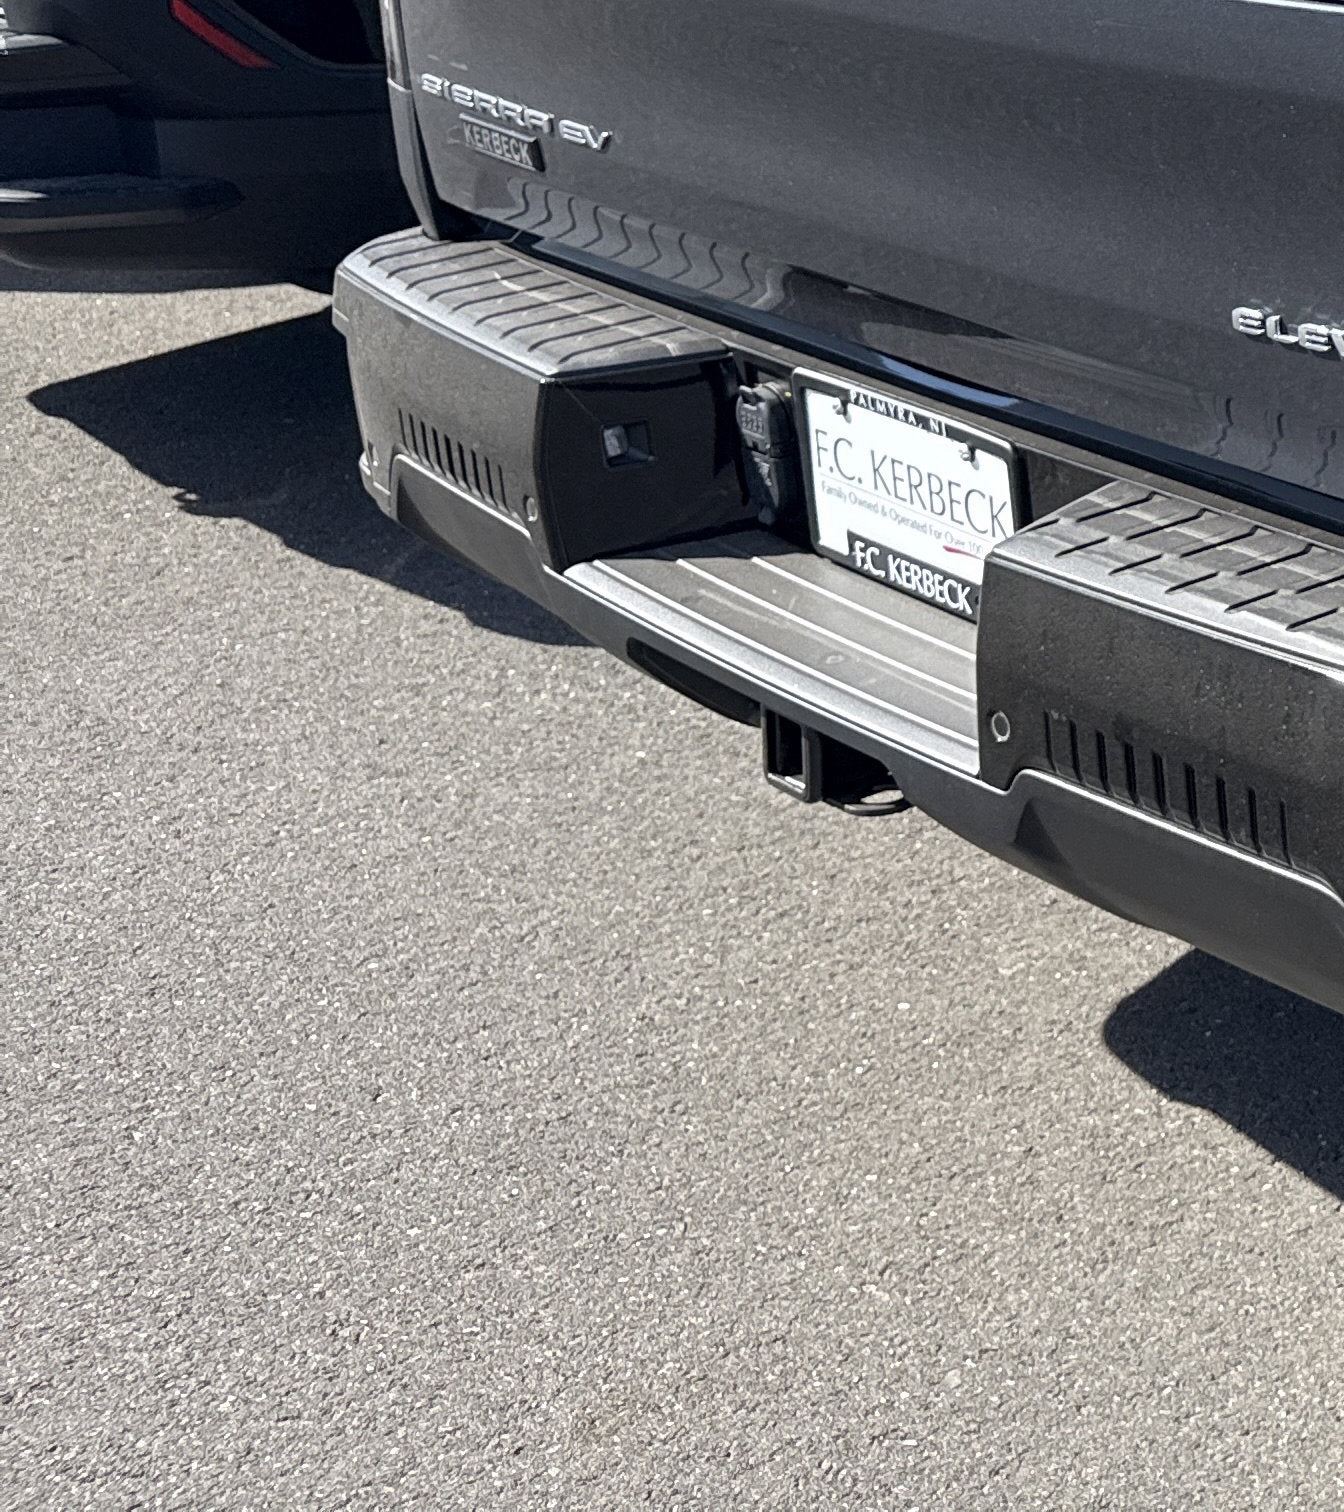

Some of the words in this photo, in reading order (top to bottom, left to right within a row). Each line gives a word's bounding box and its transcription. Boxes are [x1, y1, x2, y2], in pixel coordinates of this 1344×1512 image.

[421, 72, 555, 134] SIERRA
[558, 119, 613, 152] EV
[463, 122, 533, 168] KERBECK
[815, 428, 863, 485] F.C.
[870, 449, 1009, 539] KERBECK
[821, 479, 847, 504] Family
[848, 492, 880, 517] Owned
[889, 507, 928, 534] Operated
[853, 539, 886, 579] F.C.
[887, 553, 973, 615] KERBECK
